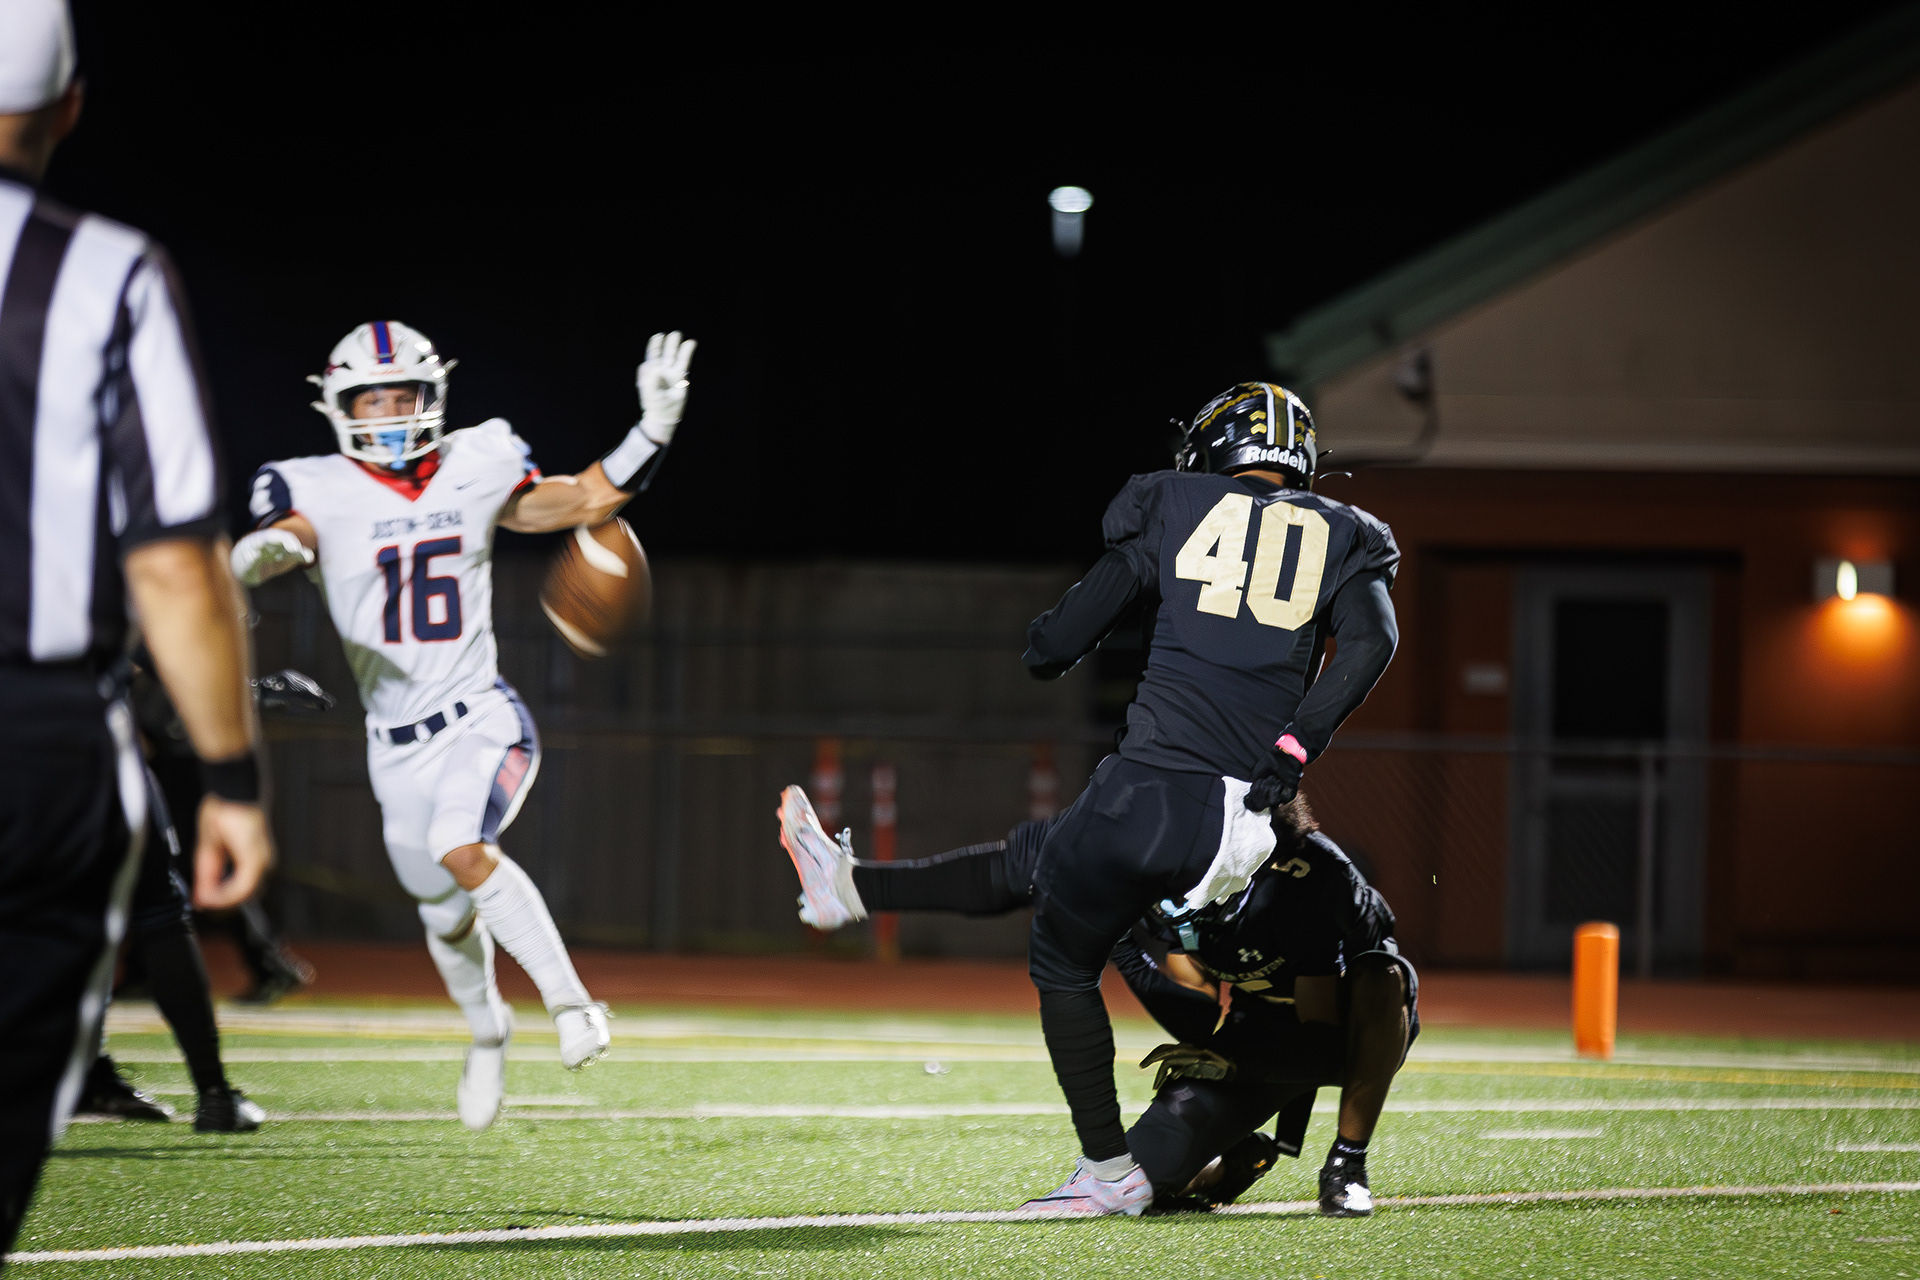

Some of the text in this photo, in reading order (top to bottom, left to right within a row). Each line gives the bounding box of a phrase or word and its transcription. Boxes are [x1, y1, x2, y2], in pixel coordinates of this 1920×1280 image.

[1244, 445, 1307, 474] Riddell
[377, 535, 463, 644] 16
[1175, 492, 1330, 631] 40
